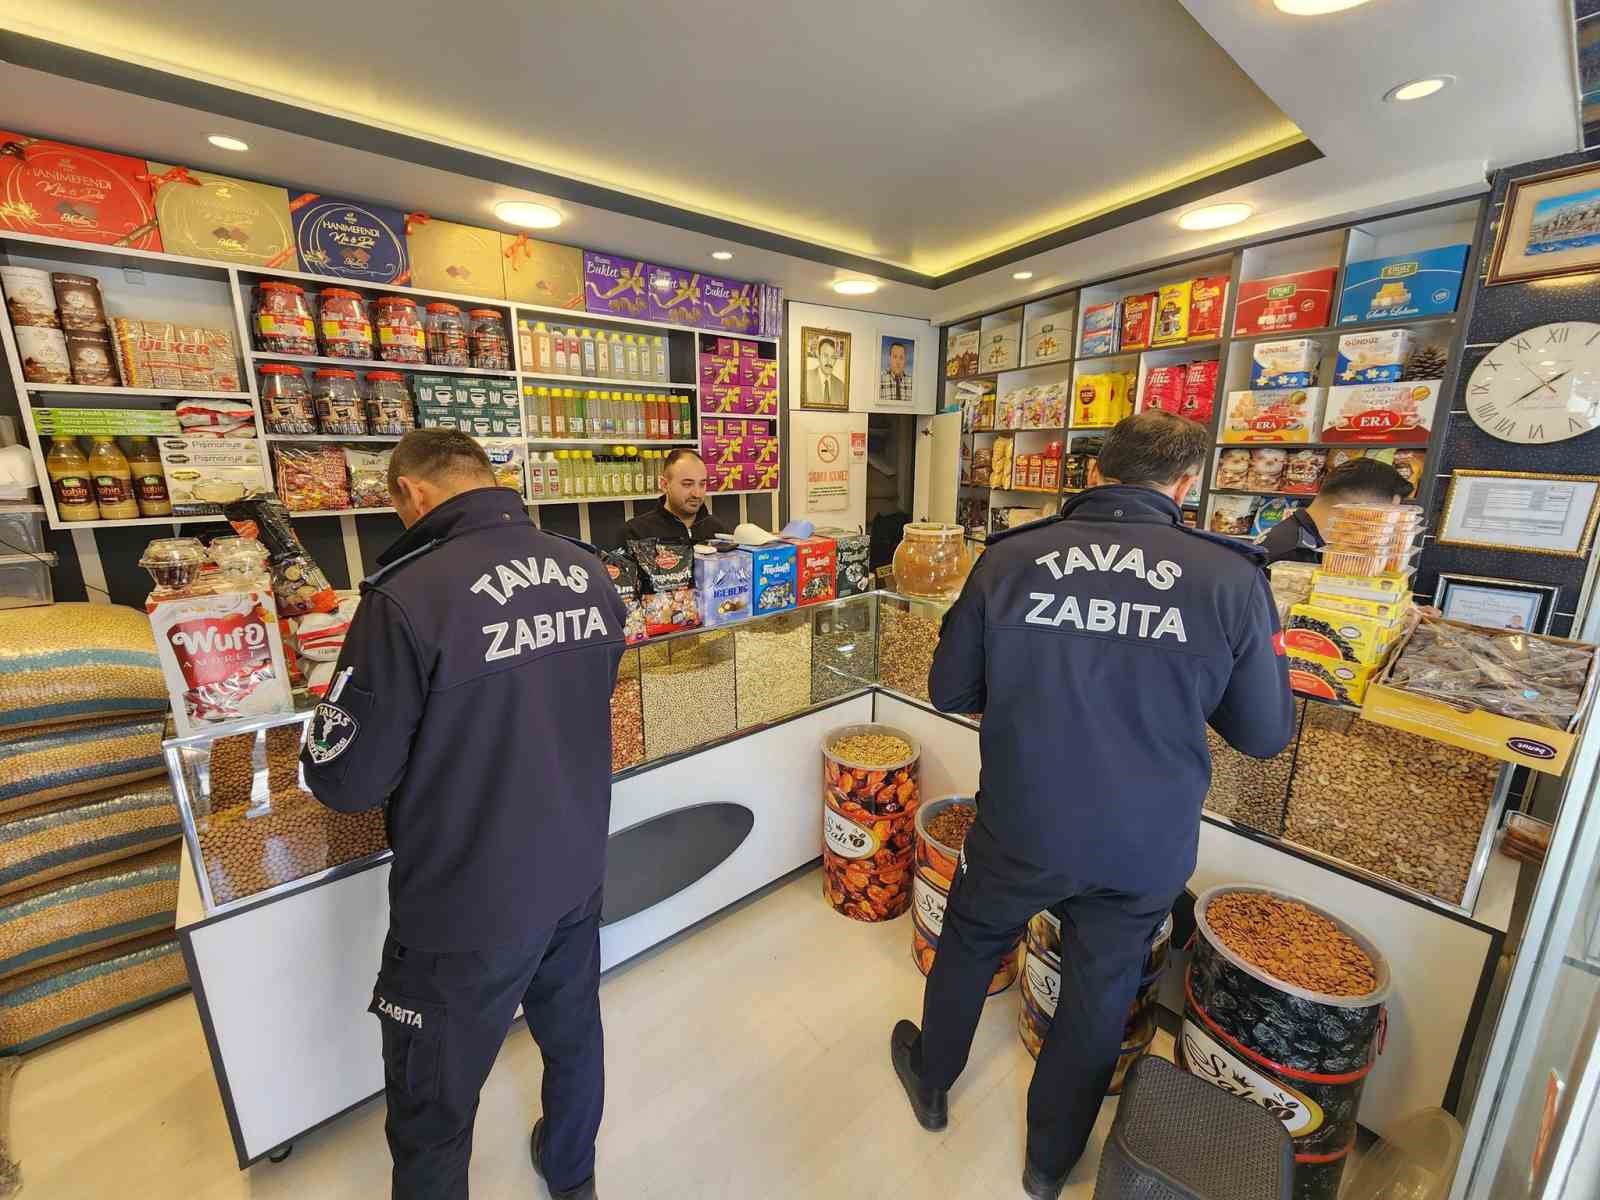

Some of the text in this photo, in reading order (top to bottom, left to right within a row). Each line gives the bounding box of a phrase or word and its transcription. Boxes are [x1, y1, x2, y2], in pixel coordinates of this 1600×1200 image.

[1545, 327, 1570, 344] XII
[1255, 421, 1277, 430] ERA
[1359, 416, 1391, 427] ERA
[470, 557, 589, 606] TAVAS
[1035, 544, 1183, 590] TAVAS
[482, 606, 608, 662] ZABITA
[1025, 592, 1187, 643] ZABITA
[319, 706, 351, 727] TAVAS
[378, 996, 423, 1029] ZABITA
